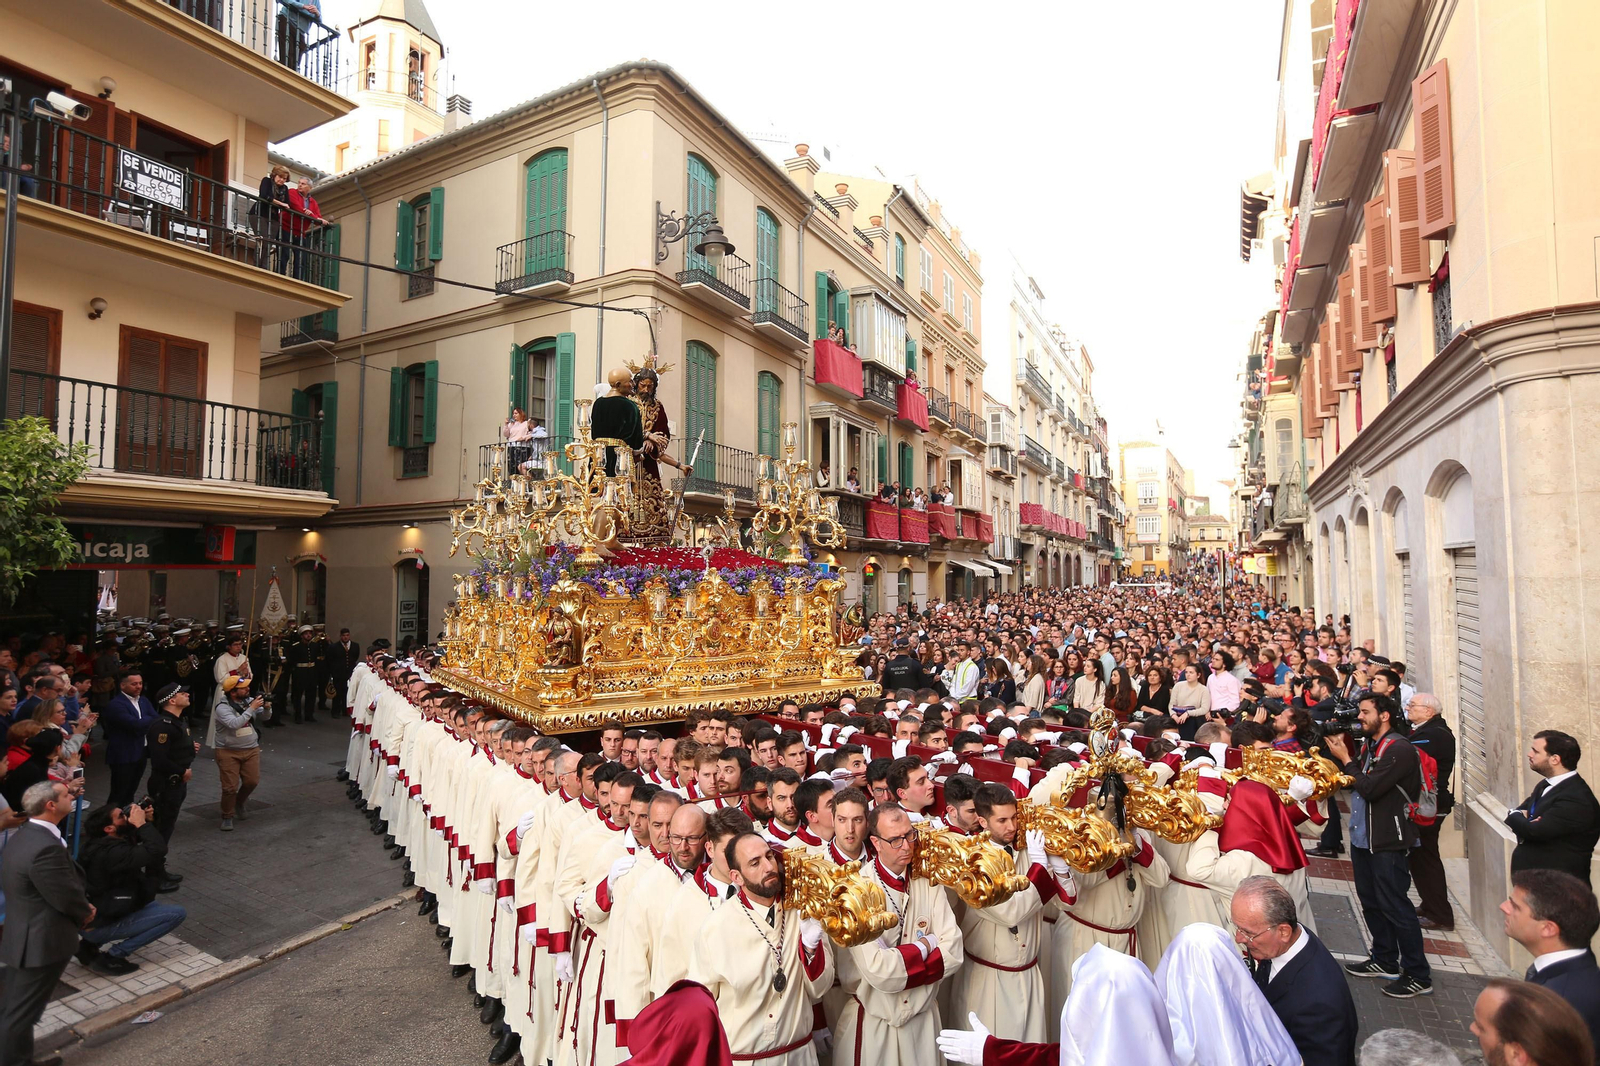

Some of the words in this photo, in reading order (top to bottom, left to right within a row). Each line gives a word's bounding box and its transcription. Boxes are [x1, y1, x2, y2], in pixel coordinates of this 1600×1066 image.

[124, 154, 140, 170] SE
[143, 160, 181, 186] VENDE
[150, 178, 172, 194] 666
[73, 533, 150, 563] nicaja
